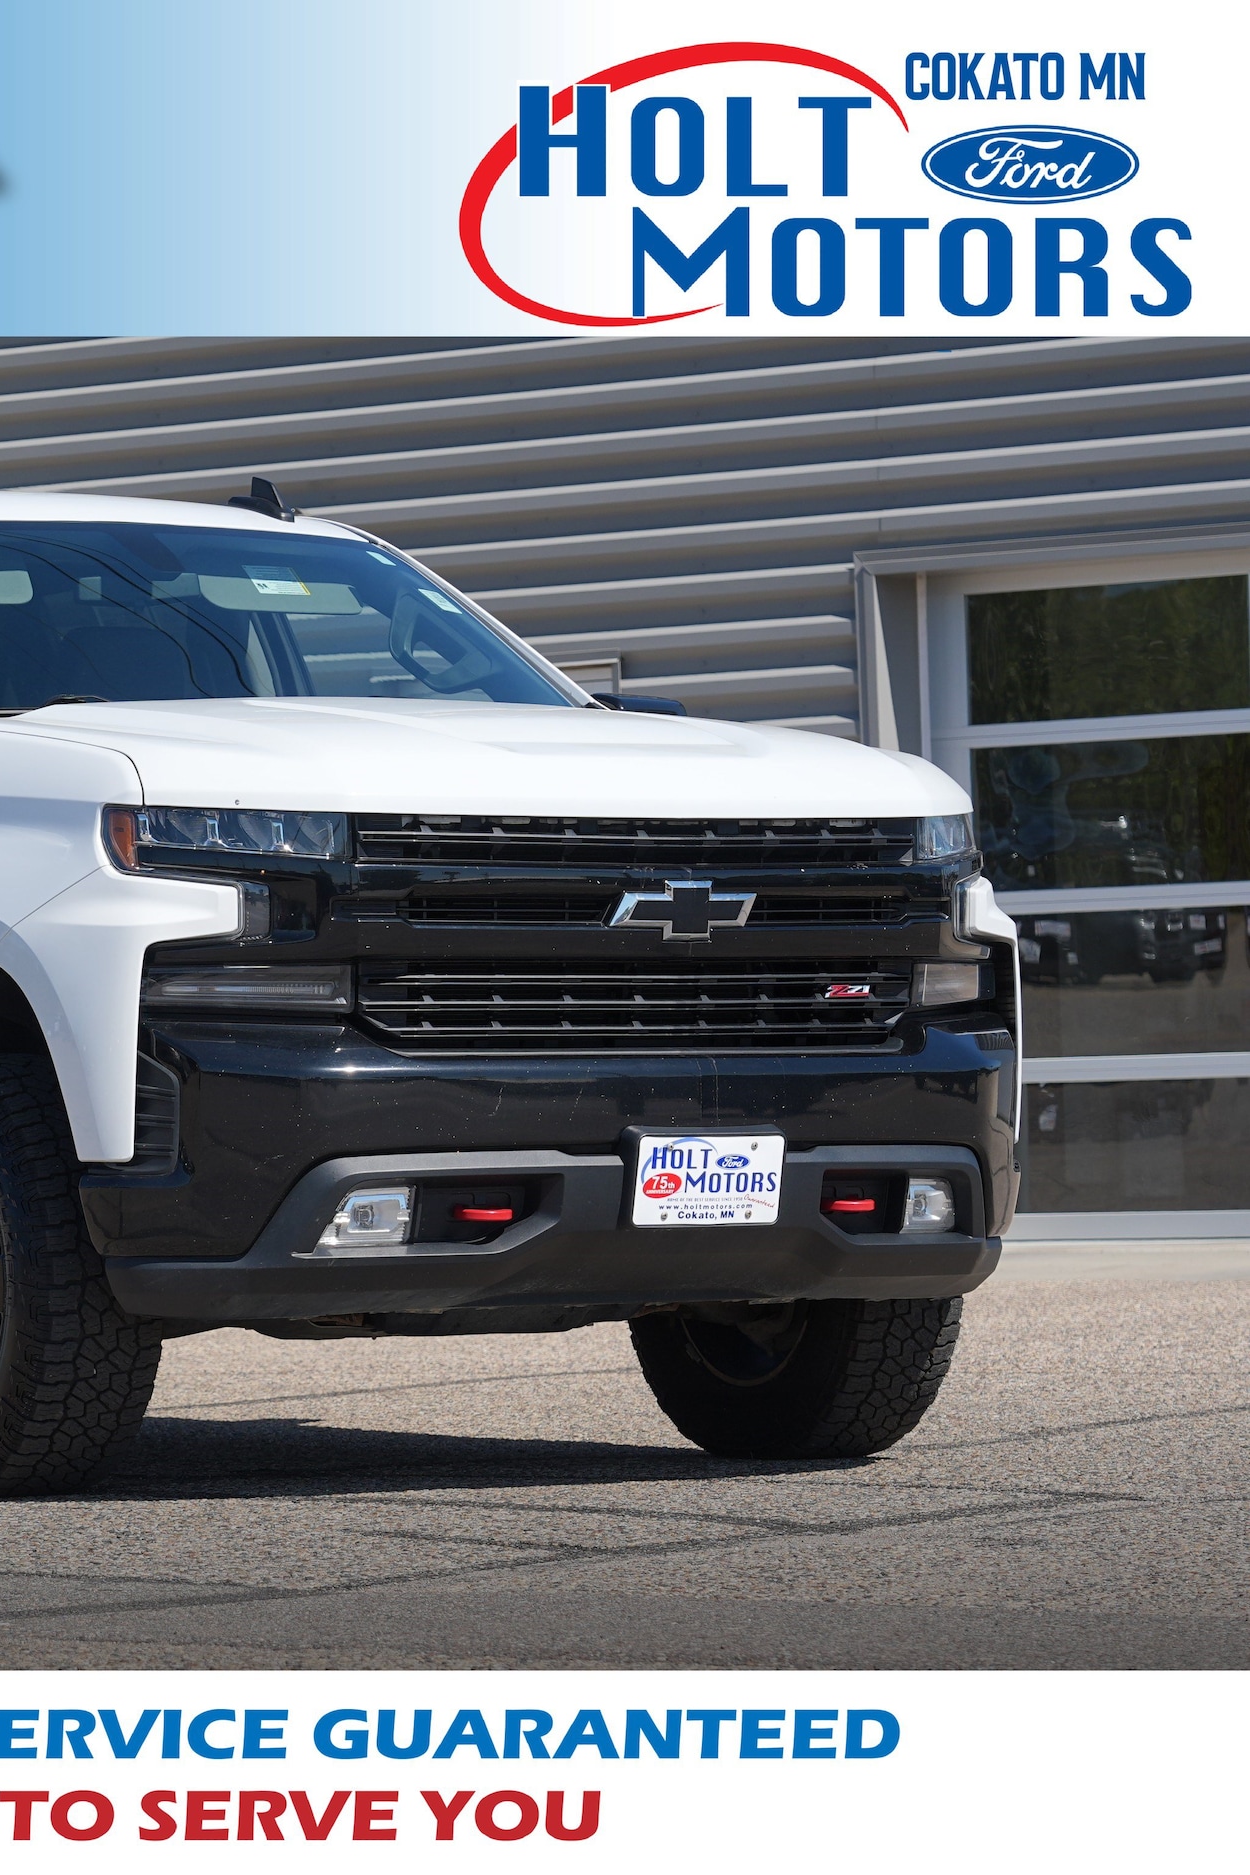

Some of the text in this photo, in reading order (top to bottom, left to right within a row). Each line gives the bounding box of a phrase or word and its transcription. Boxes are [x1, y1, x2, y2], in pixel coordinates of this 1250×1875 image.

[825, 984, 870, 998] Z71
[651, 1147, 713, 1169] HOLT
[721, 1155, 744, 1168] Ford
[651, 1175, 675, 1190] 75th
[684, 1171, 777, 1194] MOTORS
[677, 1210, 735, 1220] Cokato, MN
